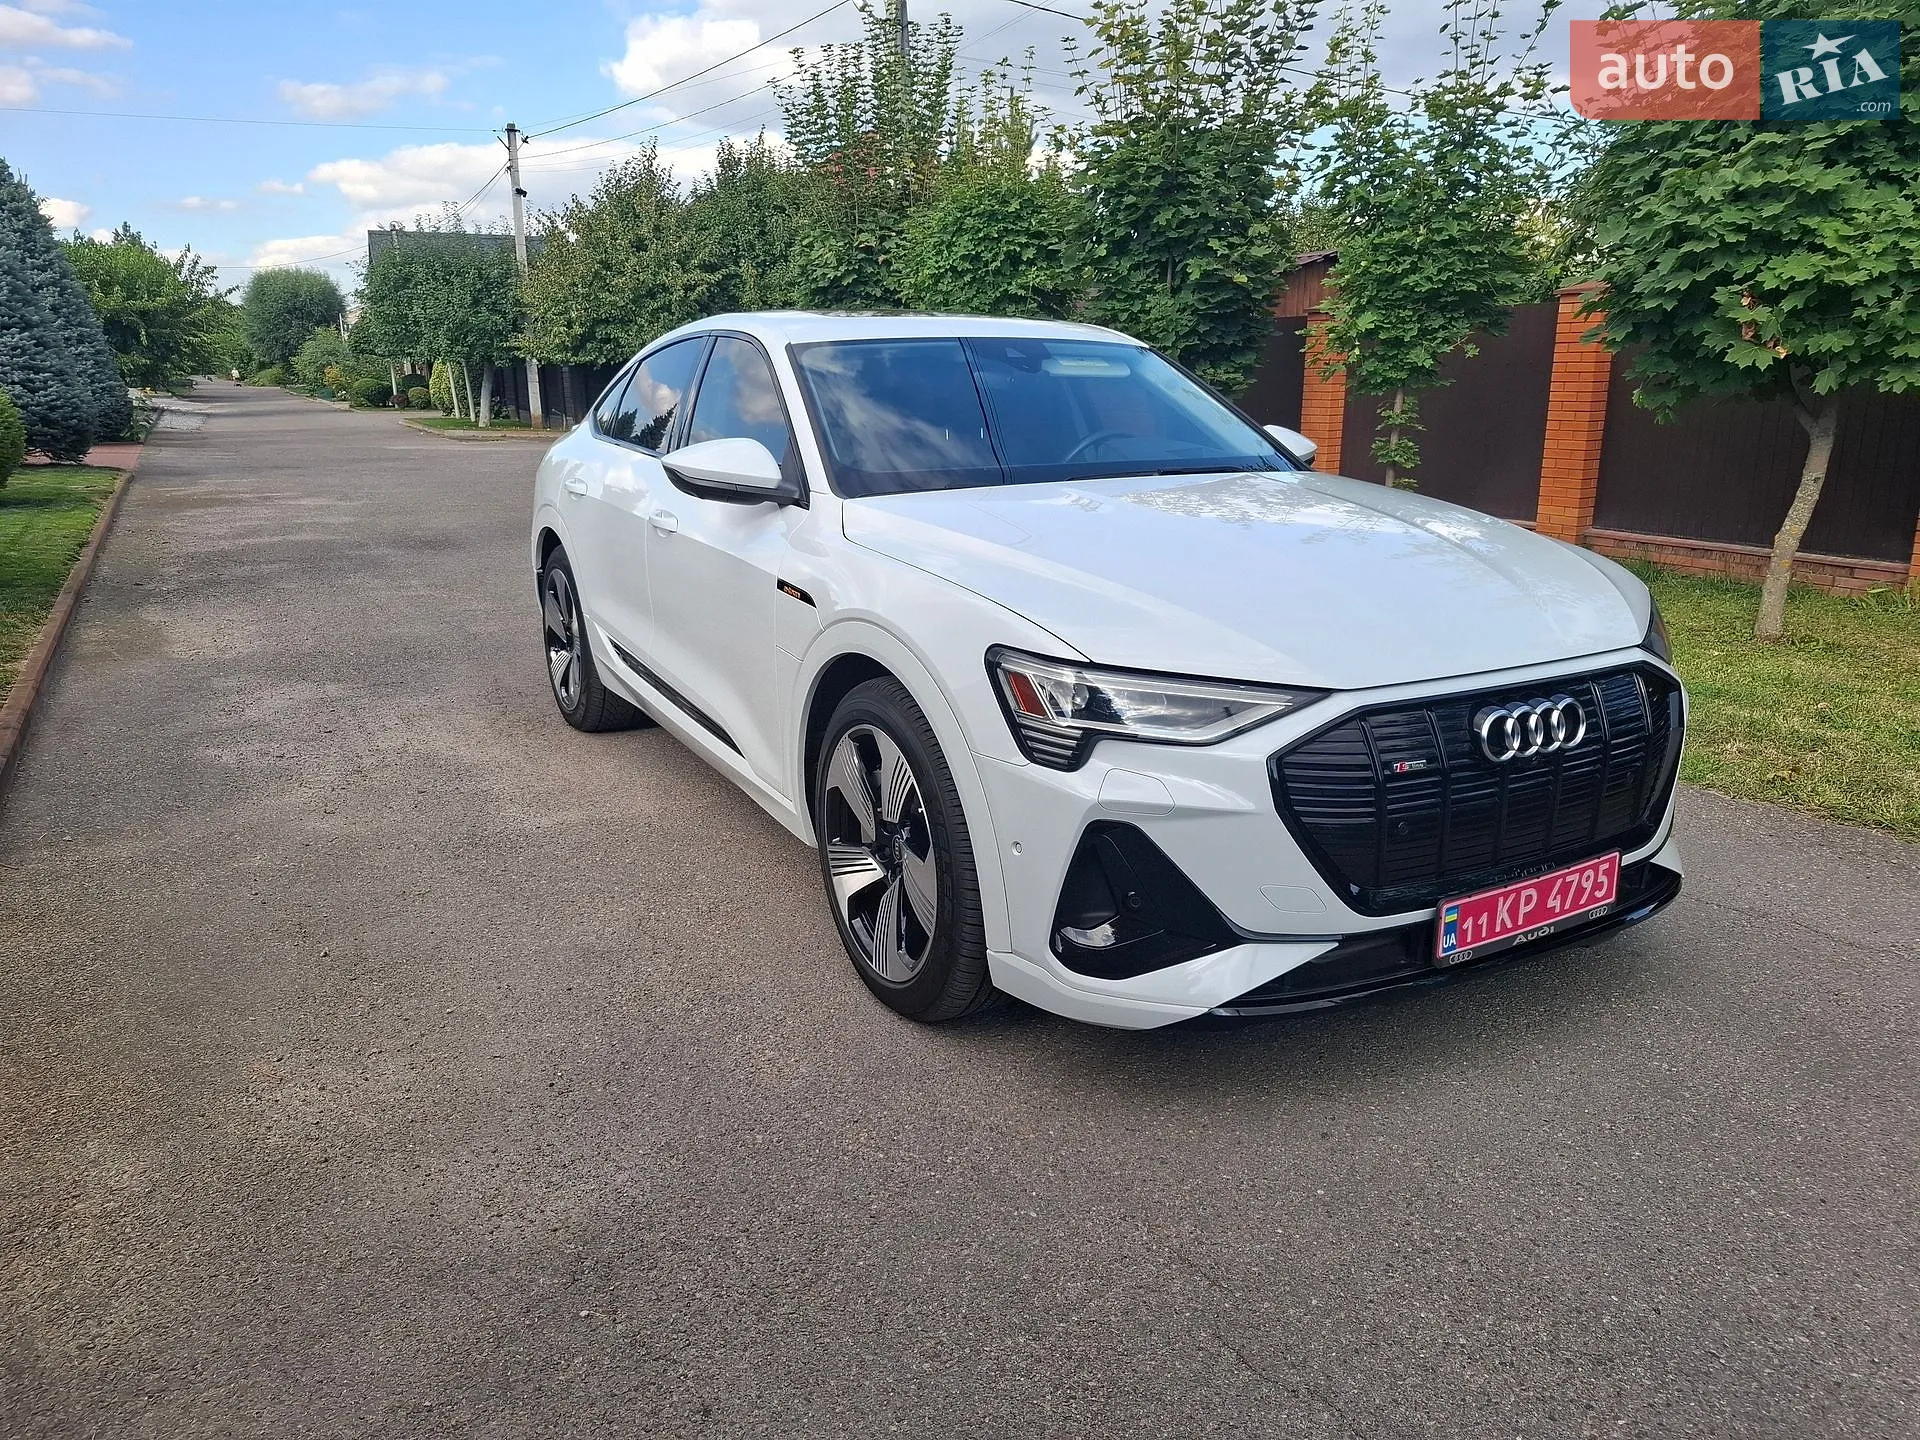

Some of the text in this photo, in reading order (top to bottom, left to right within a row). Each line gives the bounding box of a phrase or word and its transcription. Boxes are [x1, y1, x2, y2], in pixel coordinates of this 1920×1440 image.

[1462, 911, 1488, 943] 11
[1495, 888, 1538, 932] KP
[1547, 862, 1610, 913] 4795
[1443, 932, 1456, 948] UA
[1512, 925, 1555, 946] Audi
